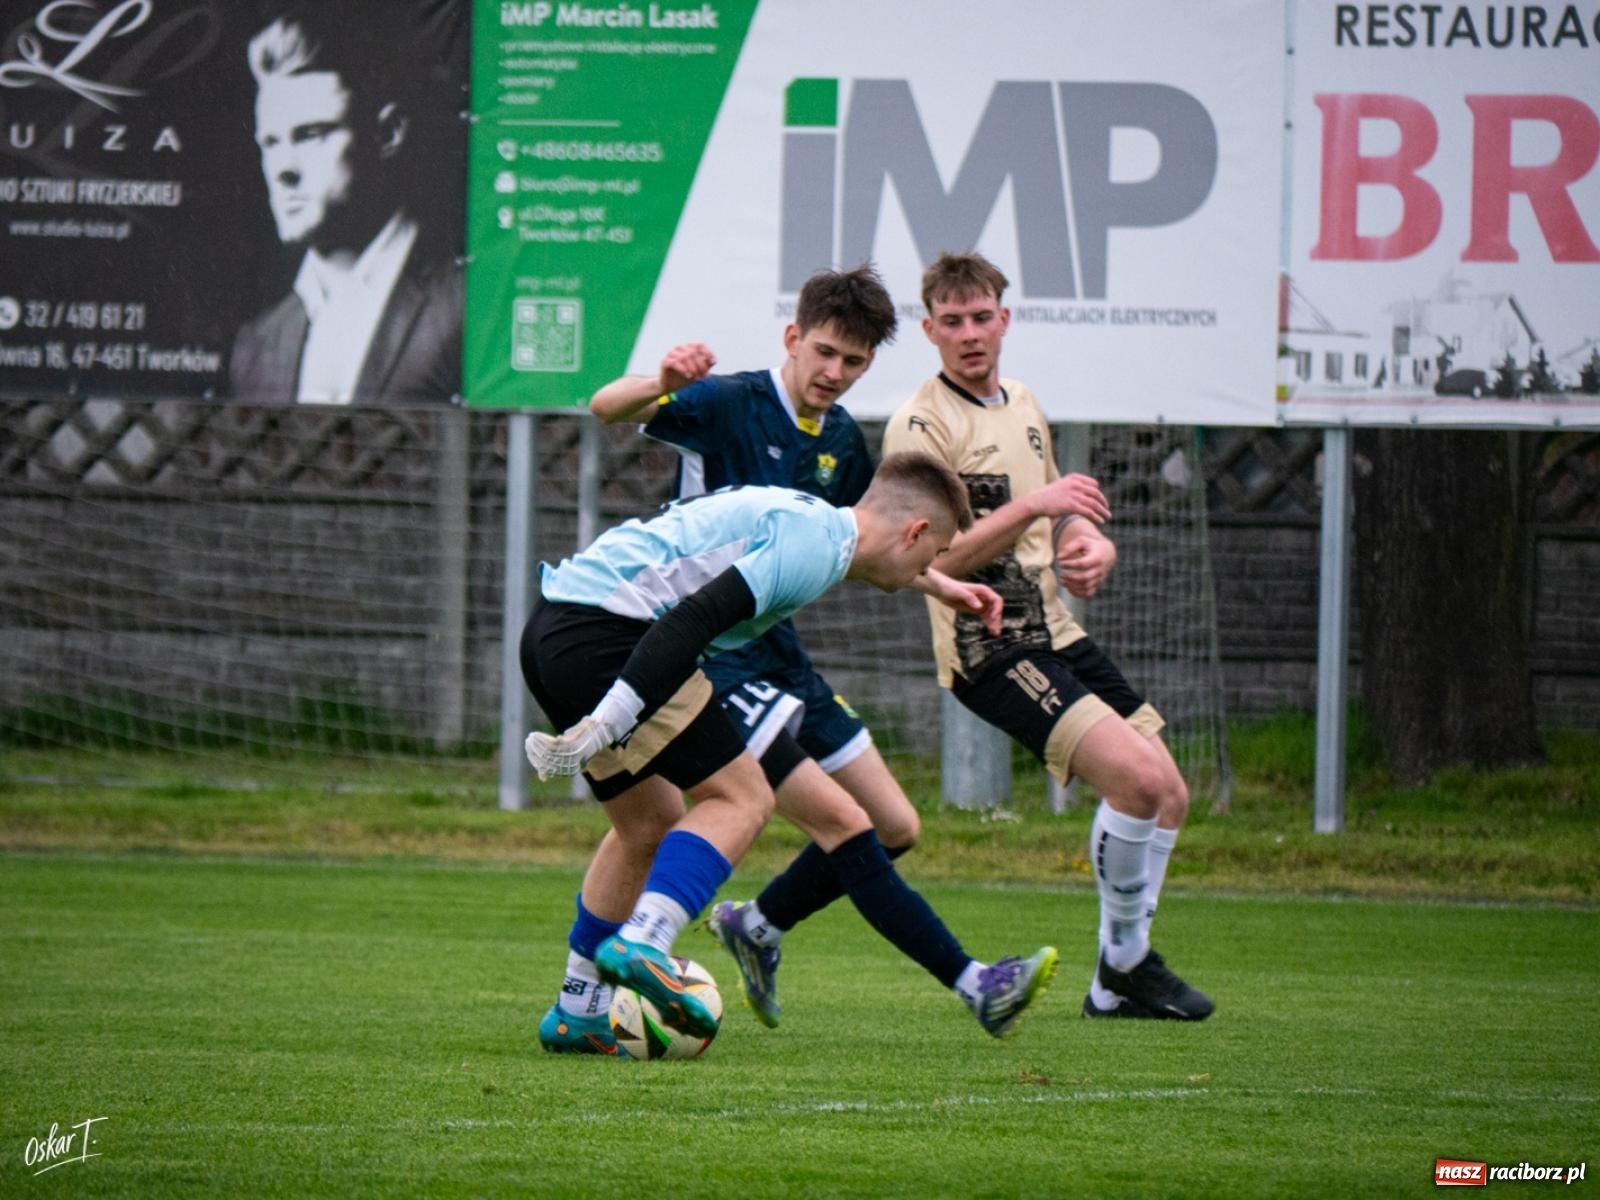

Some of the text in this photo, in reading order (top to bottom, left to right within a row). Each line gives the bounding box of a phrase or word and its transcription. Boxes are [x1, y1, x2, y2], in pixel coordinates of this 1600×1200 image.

[500, 2, 719, 29] iMP Marcin Lasak
[24, 302, 49, 328] 32
[1005, 659, 1050, 702] 18
